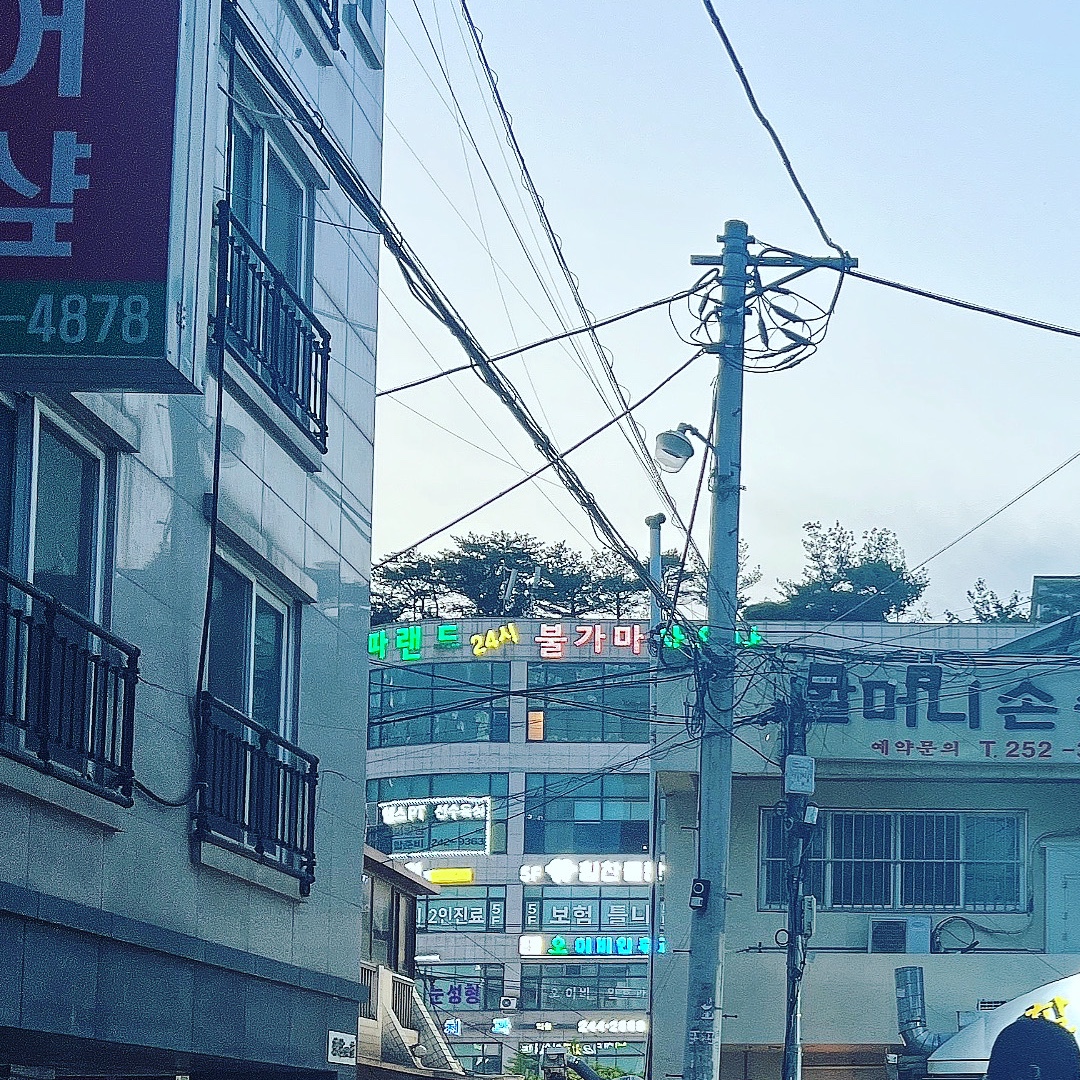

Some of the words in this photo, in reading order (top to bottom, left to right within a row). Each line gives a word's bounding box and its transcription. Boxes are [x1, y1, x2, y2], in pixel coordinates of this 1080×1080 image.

[535, 623, 644, 659] 불가마
[871, 739, 960, 758] 예약문의
[427, 906, 485, 926] 2인진료
[550, 905, 592, 924] 보험
